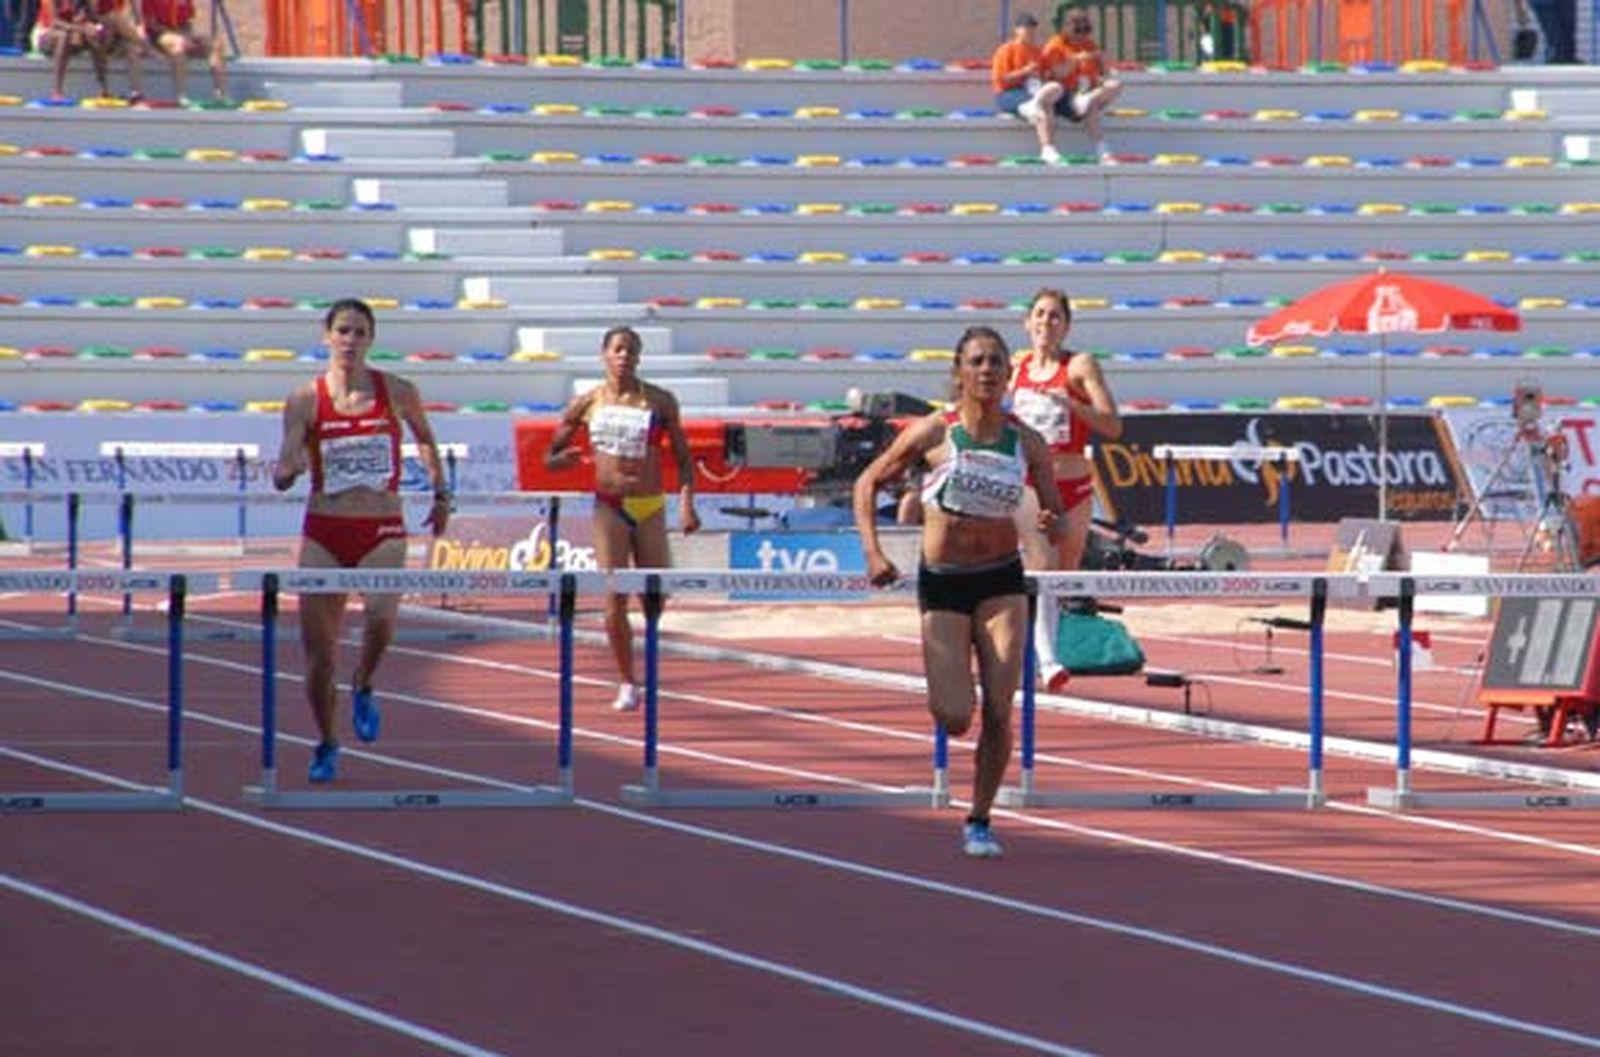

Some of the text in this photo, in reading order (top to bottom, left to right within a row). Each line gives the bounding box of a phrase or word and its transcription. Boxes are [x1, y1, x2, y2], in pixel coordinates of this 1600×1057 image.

[63, 457, 219, 483] FERNANDO
[1300, 442, 1447, 486] Pastora
[432, 539, 508, 571] Divina
[755, 540, 839, 574] tve
[1096, 577, 1129, 592] SAN
[1130, 577, 1218, 592] FERNANDO
[1221, 577, 1259, 593] 2010
[1472, 577, 1504, 593] SAN
